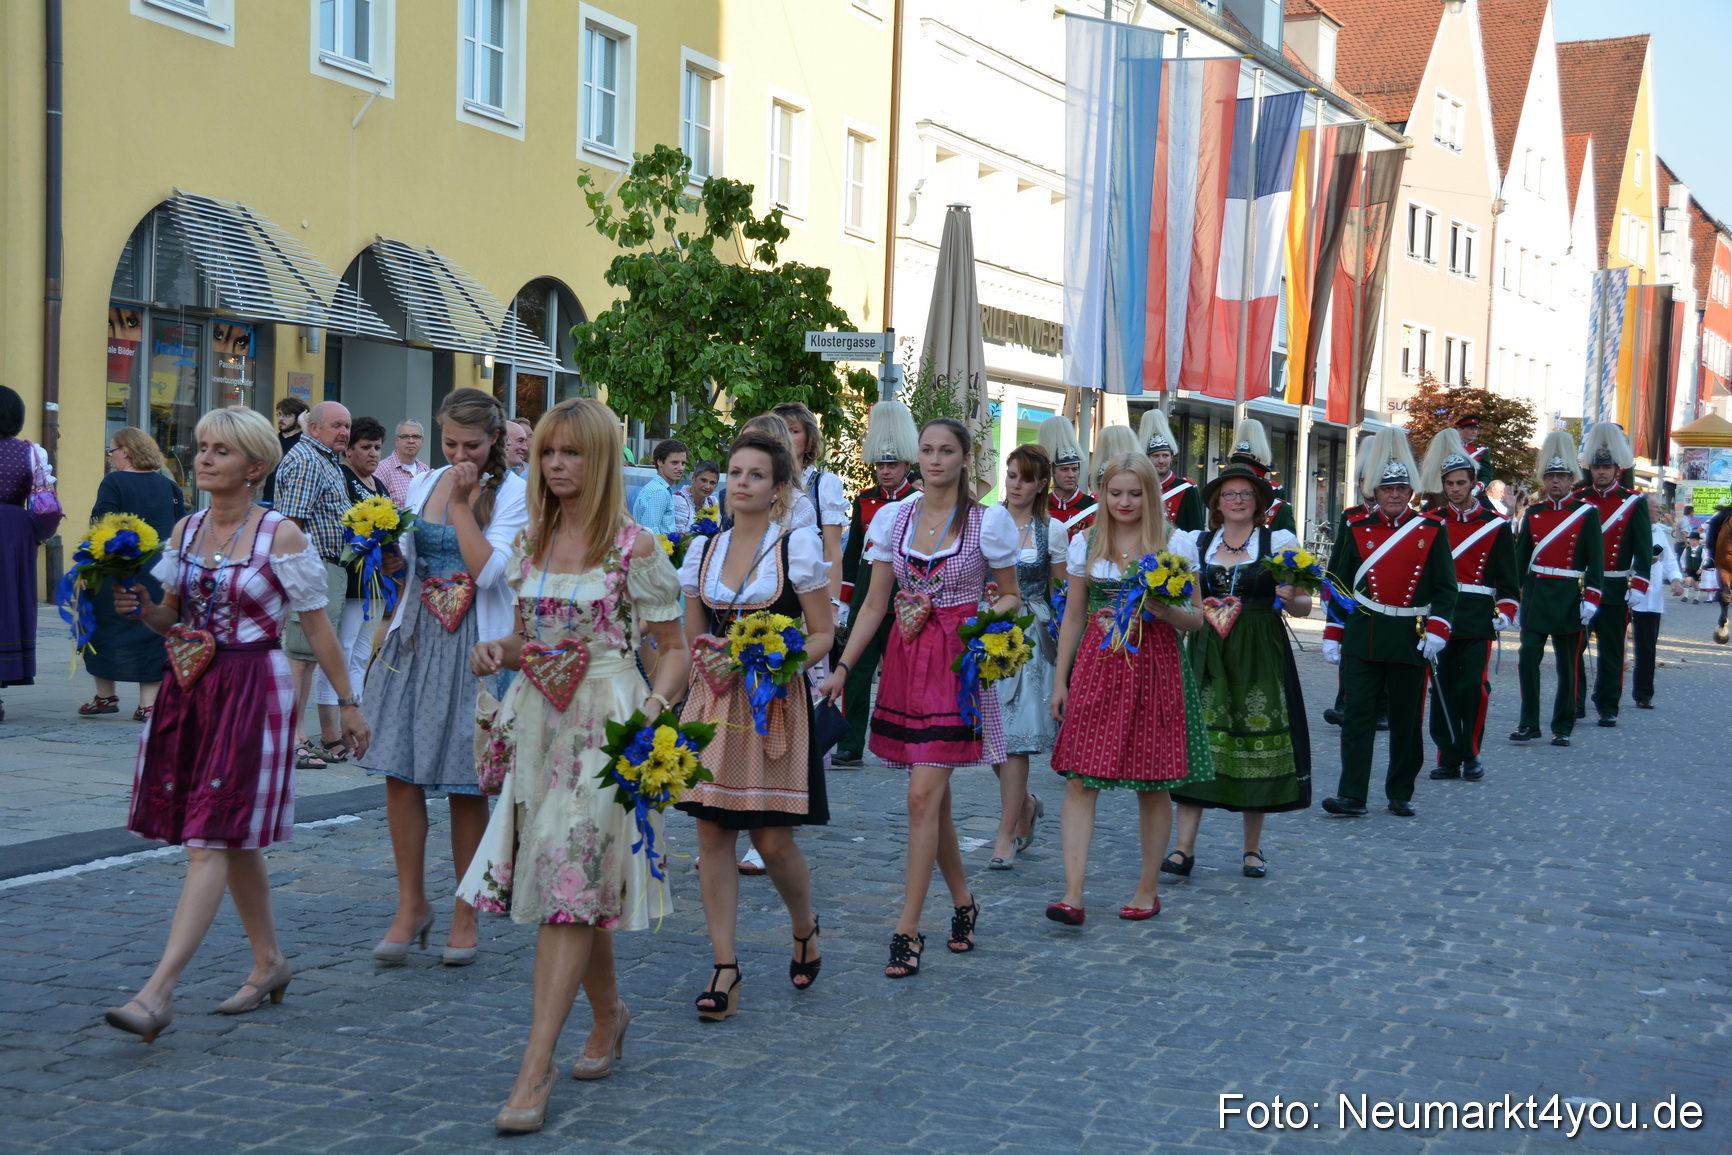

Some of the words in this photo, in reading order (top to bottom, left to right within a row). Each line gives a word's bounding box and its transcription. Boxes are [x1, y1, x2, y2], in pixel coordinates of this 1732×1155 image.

[979, 304, 1025, 345] RILLEN
[1028, 316, 1064, 354] WEBE
[811, 335, 876, 350] Klostergasse
[118, 346, 135, 356] Bilder
[219, 359, 245, 370] Passbilde
